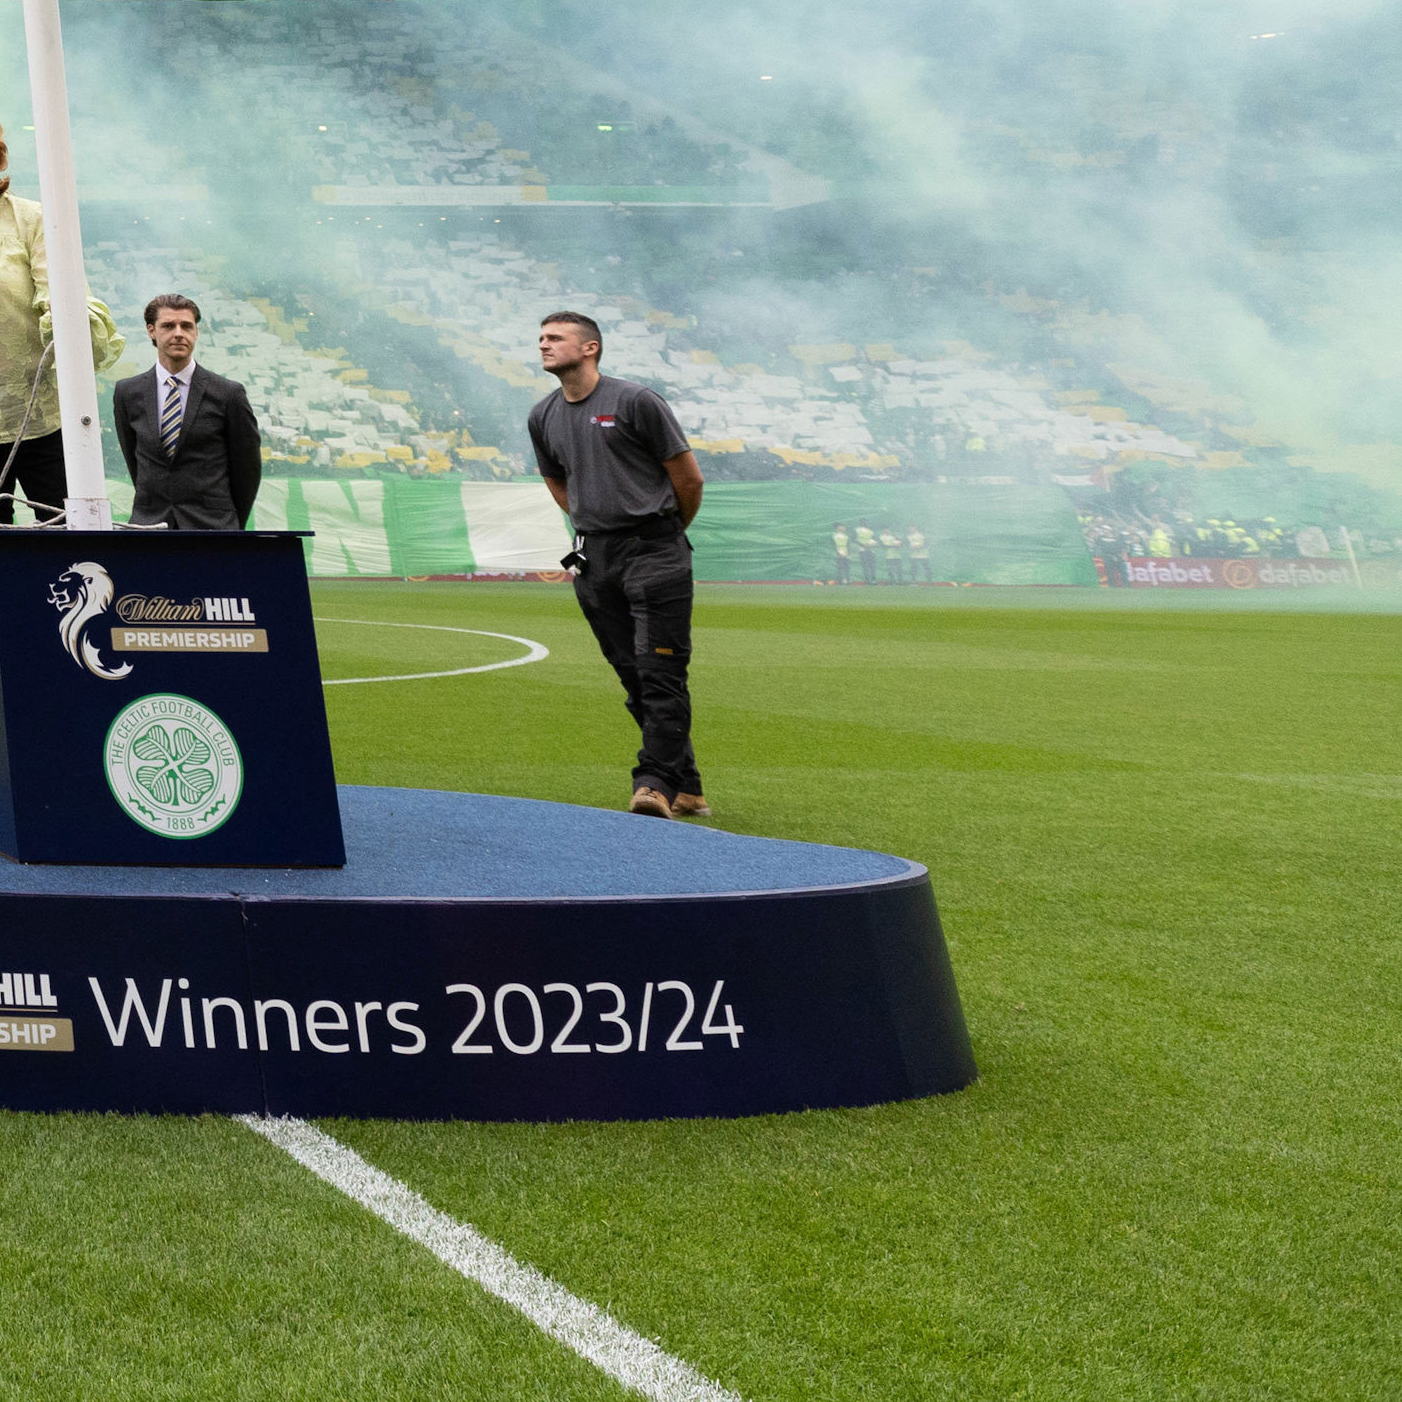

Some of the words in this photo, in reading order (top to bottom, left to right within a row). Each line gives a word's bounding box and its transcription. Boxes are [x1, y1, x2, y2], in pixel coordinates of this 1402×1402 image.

[115, 593, 205, 622] William
[205, 598, 256, 621] HILL
[123, 632, 256, 648] PREMIERSHIP
[116, 705, 151, 739] CELTIC
[151, 700, 214, 733] FOOTBALL
[111, 740, 125, 766] THE
[212, 732, 235, 767] CLUB
[166, 816, 196, 831] 1888
[88, 976, 427, 1055] Winners
[445, 979, 745, 1055] 2023/24
